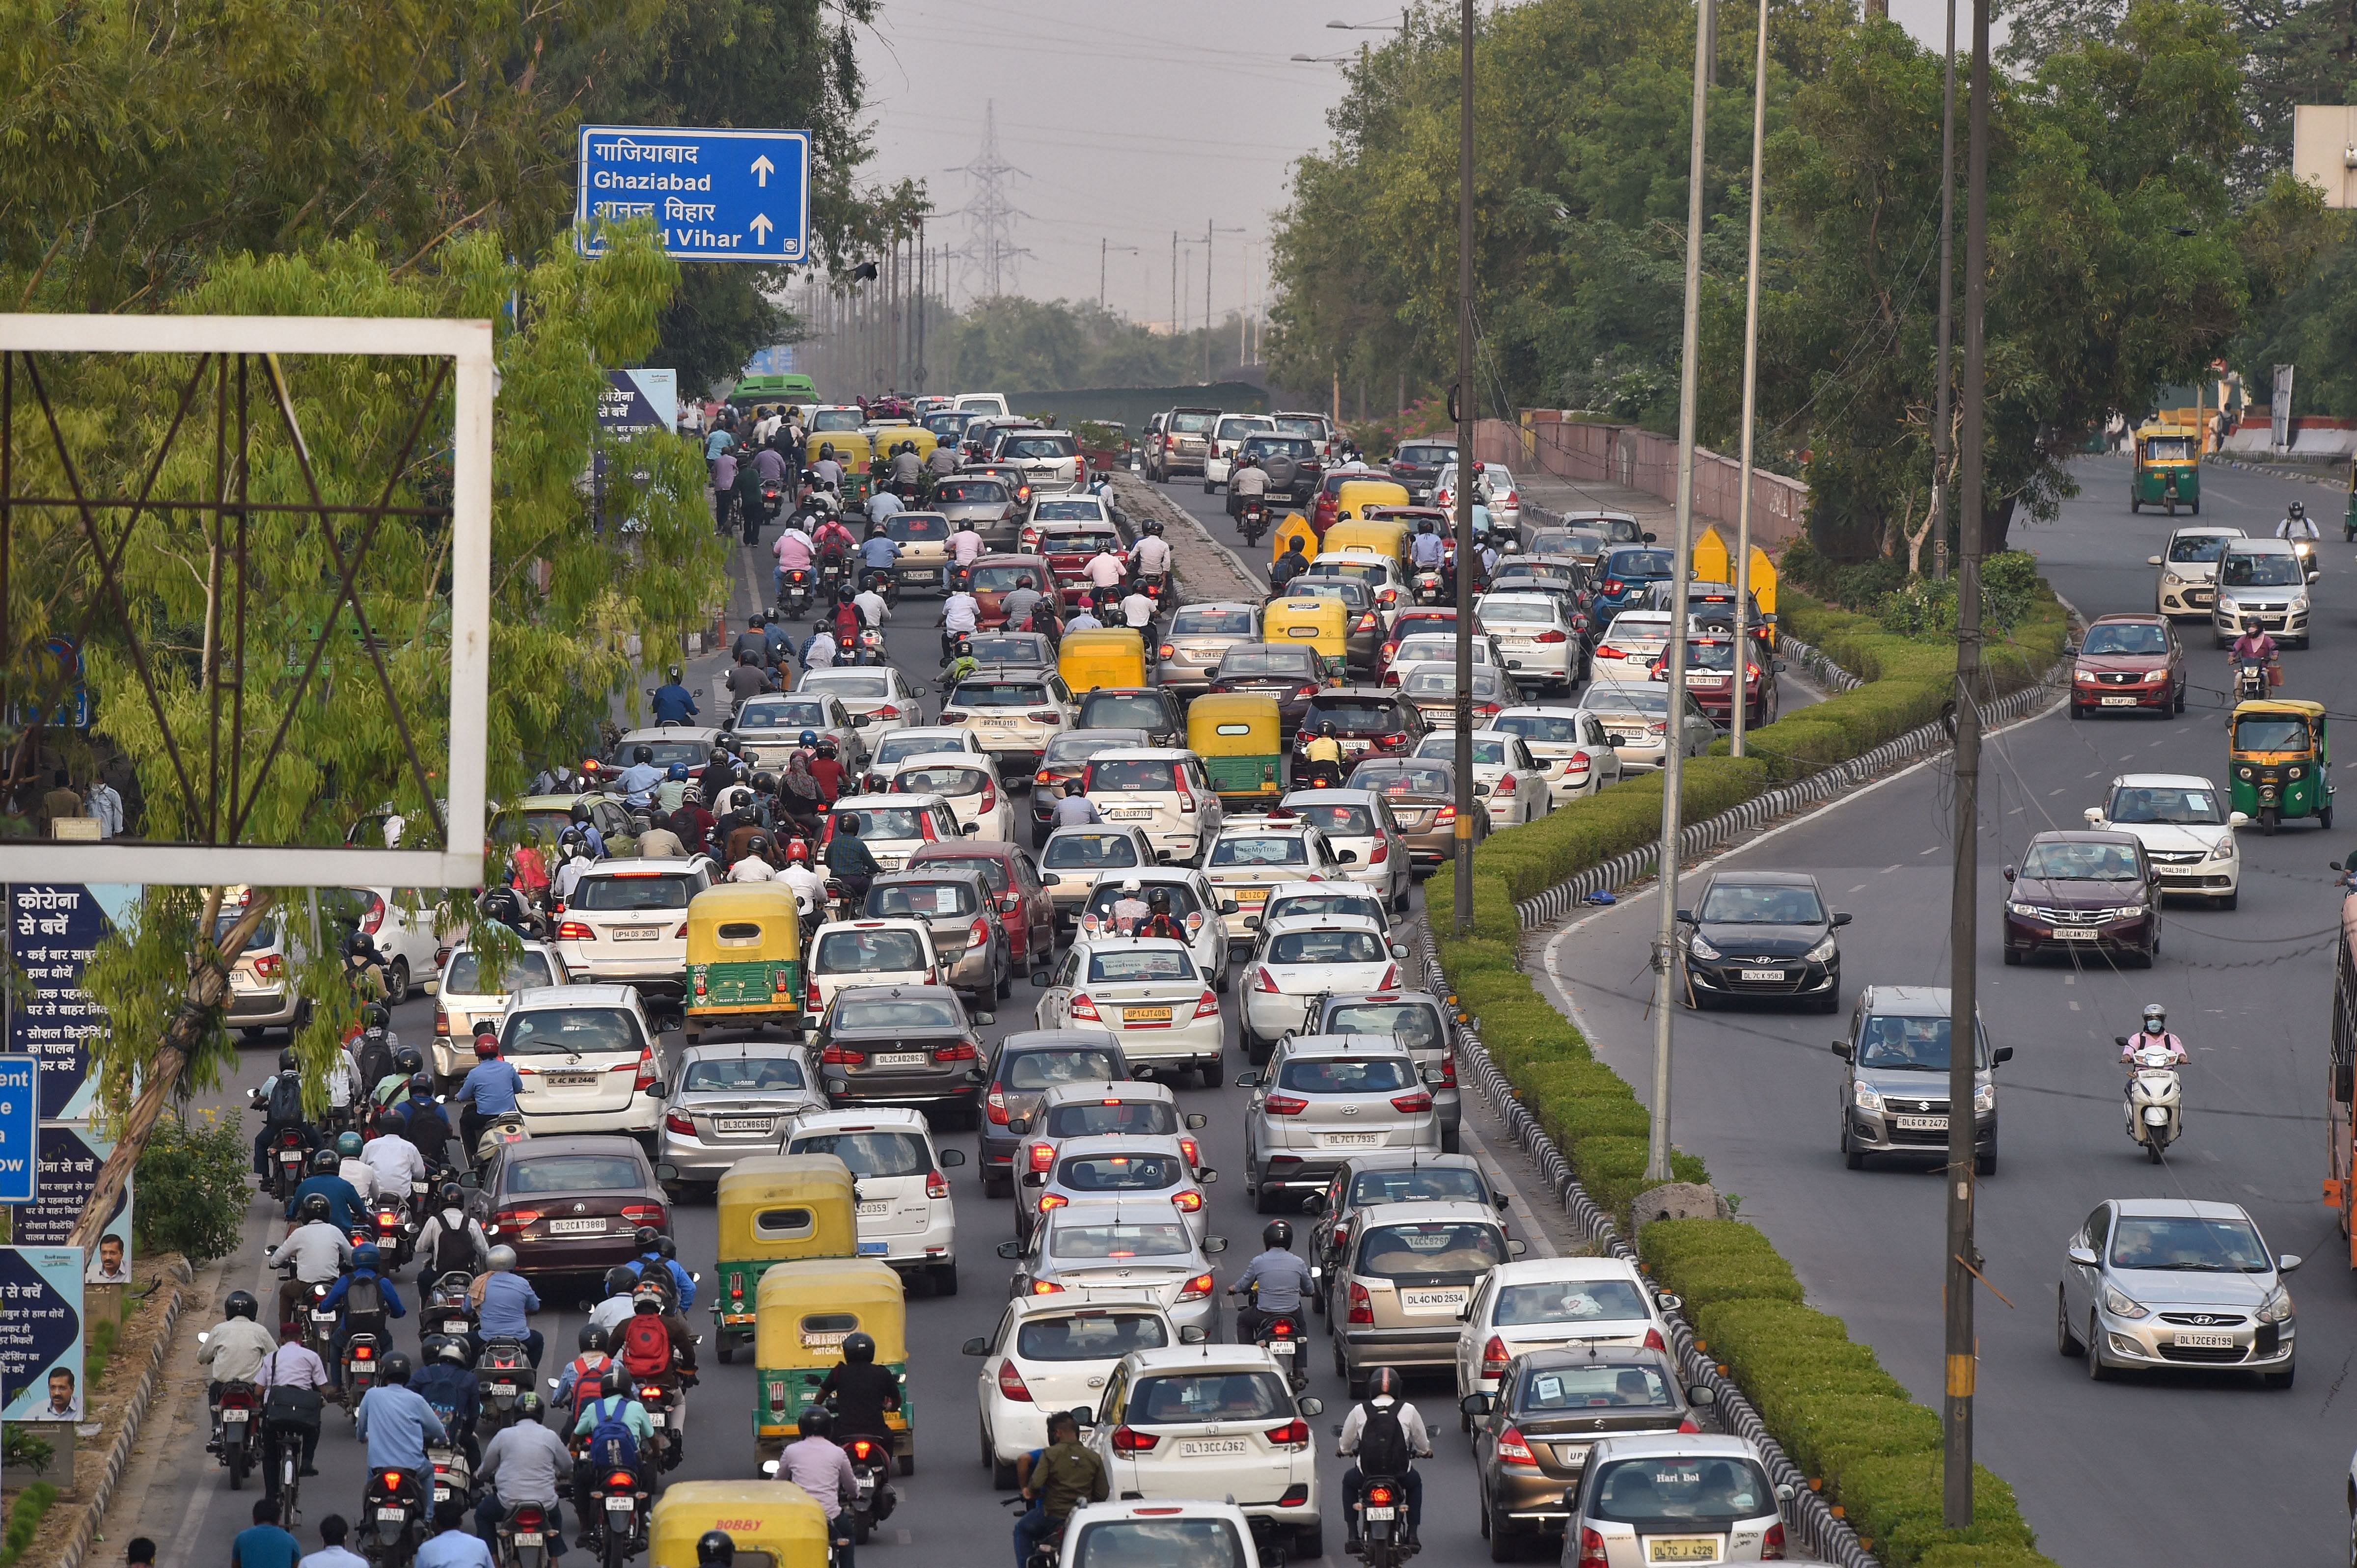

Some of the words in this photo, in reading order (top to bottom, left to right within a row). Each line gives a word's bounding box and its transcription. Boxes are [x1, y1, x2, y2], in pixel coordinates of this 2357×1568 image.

[594, 137, 699, 164] गाजियाबाद
[594, 171, 711, 191] Ghaziabad
[664, 196, 716, 222] विहार
[676, 229, 742, 247] Vihar
[611, 403, 629, 417] बचें
[17, 887, 80, 909] कोरोना
[17, 912, 37, 935] से
[39, 912, 69, 935] बचें
[27, 946, 47, 963] कई
[49, 949, 69, 960] बार
[27, 968, 49, 979] हाथ
[51, 965, 74, 980] धोयें
[27, 1005, 43, 1015] घर
[45, 1001, 56, 1016] से
[59, 1005, 86, 1016] बाहर
[27, 1025, 61, 1039] सोशल
[27, 1044, 43, 1054] का
[44, 1044, 75, 1054] पालन
[57, 1057, 76, 1071] करें
[1330, 1135, 1339, 1144] DL
[1342, 1135, 1355, 1143] 7CT
[1357, 1135, 1375, 1143] 7935
[60, 1158, 73, 1172] से
[75, 1157, 94, 1172] बचें
[54, 1183, 74, 1192] साबुन
[75, 1181, 82, 1190] से
[76, 1195, 83, 1204] ही
[37, 1206, 45, 1215] से
[867, 1204, 887, 1213] 0359
[25, 1220, 47, 1229] सोशल
[555, 1220, 605, 1230] DL2CAT3888
[6, 1282, 19, 1298] से
[22, 1282, 42, 1298] बचें
[1444, 1294, 1463, 1302] 2534
[22, 1308, 31, 1318] से
[49, 1307, 64, 1318] धोयें
[22, 1324, 30, 1333] ही
[10, 1334, 33, 1345] निकलें
[806, 1335, 821, 1345] PUB
[822, 1334, 827, 1344] &
[2180, 1335, 2232, 1345] DL12CE8199
[12, 1363, 25, 1374] करें
[1657, 1474, 1678, 1483] Hari
[1683, 1473, 1699, 1482] Bol
[715, 1520, 763, 1531] BOBBY
[1655, 1547, 1666, 1556] DL
[1667, 1547, 1678, 1555] 7C
[1693, 1545, 1713, 1554] 4229
